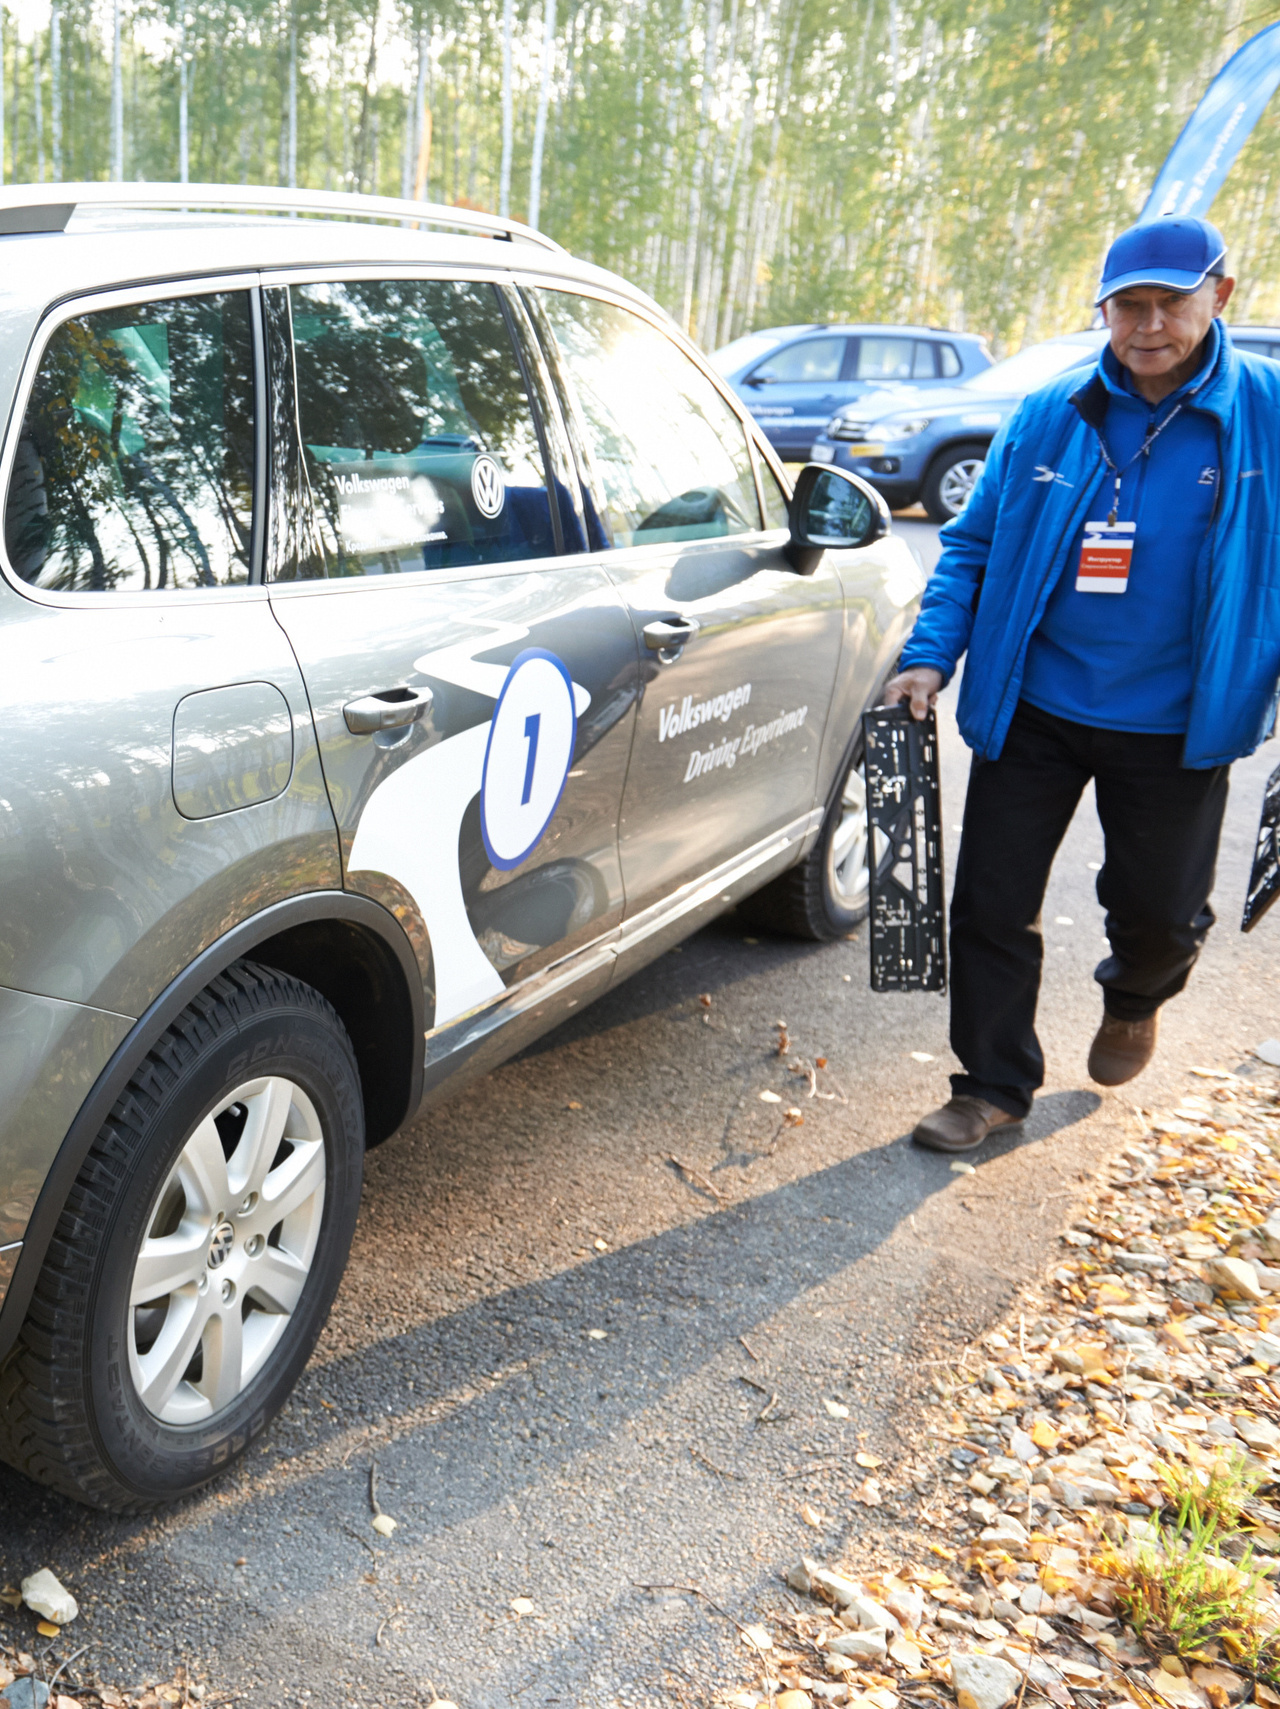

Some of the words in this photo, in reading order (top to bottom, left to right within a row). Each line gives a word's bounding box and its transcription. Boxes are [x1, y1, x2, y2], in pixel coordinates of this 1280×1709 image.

[334, 473, 410, 495] Volkswagen
[658, 683, 752, 743] Volkswagen
[683, 737, 742, 784] Driving
[738, 705, 809, 757] Experience
[521, 713, 541, 806] 1
